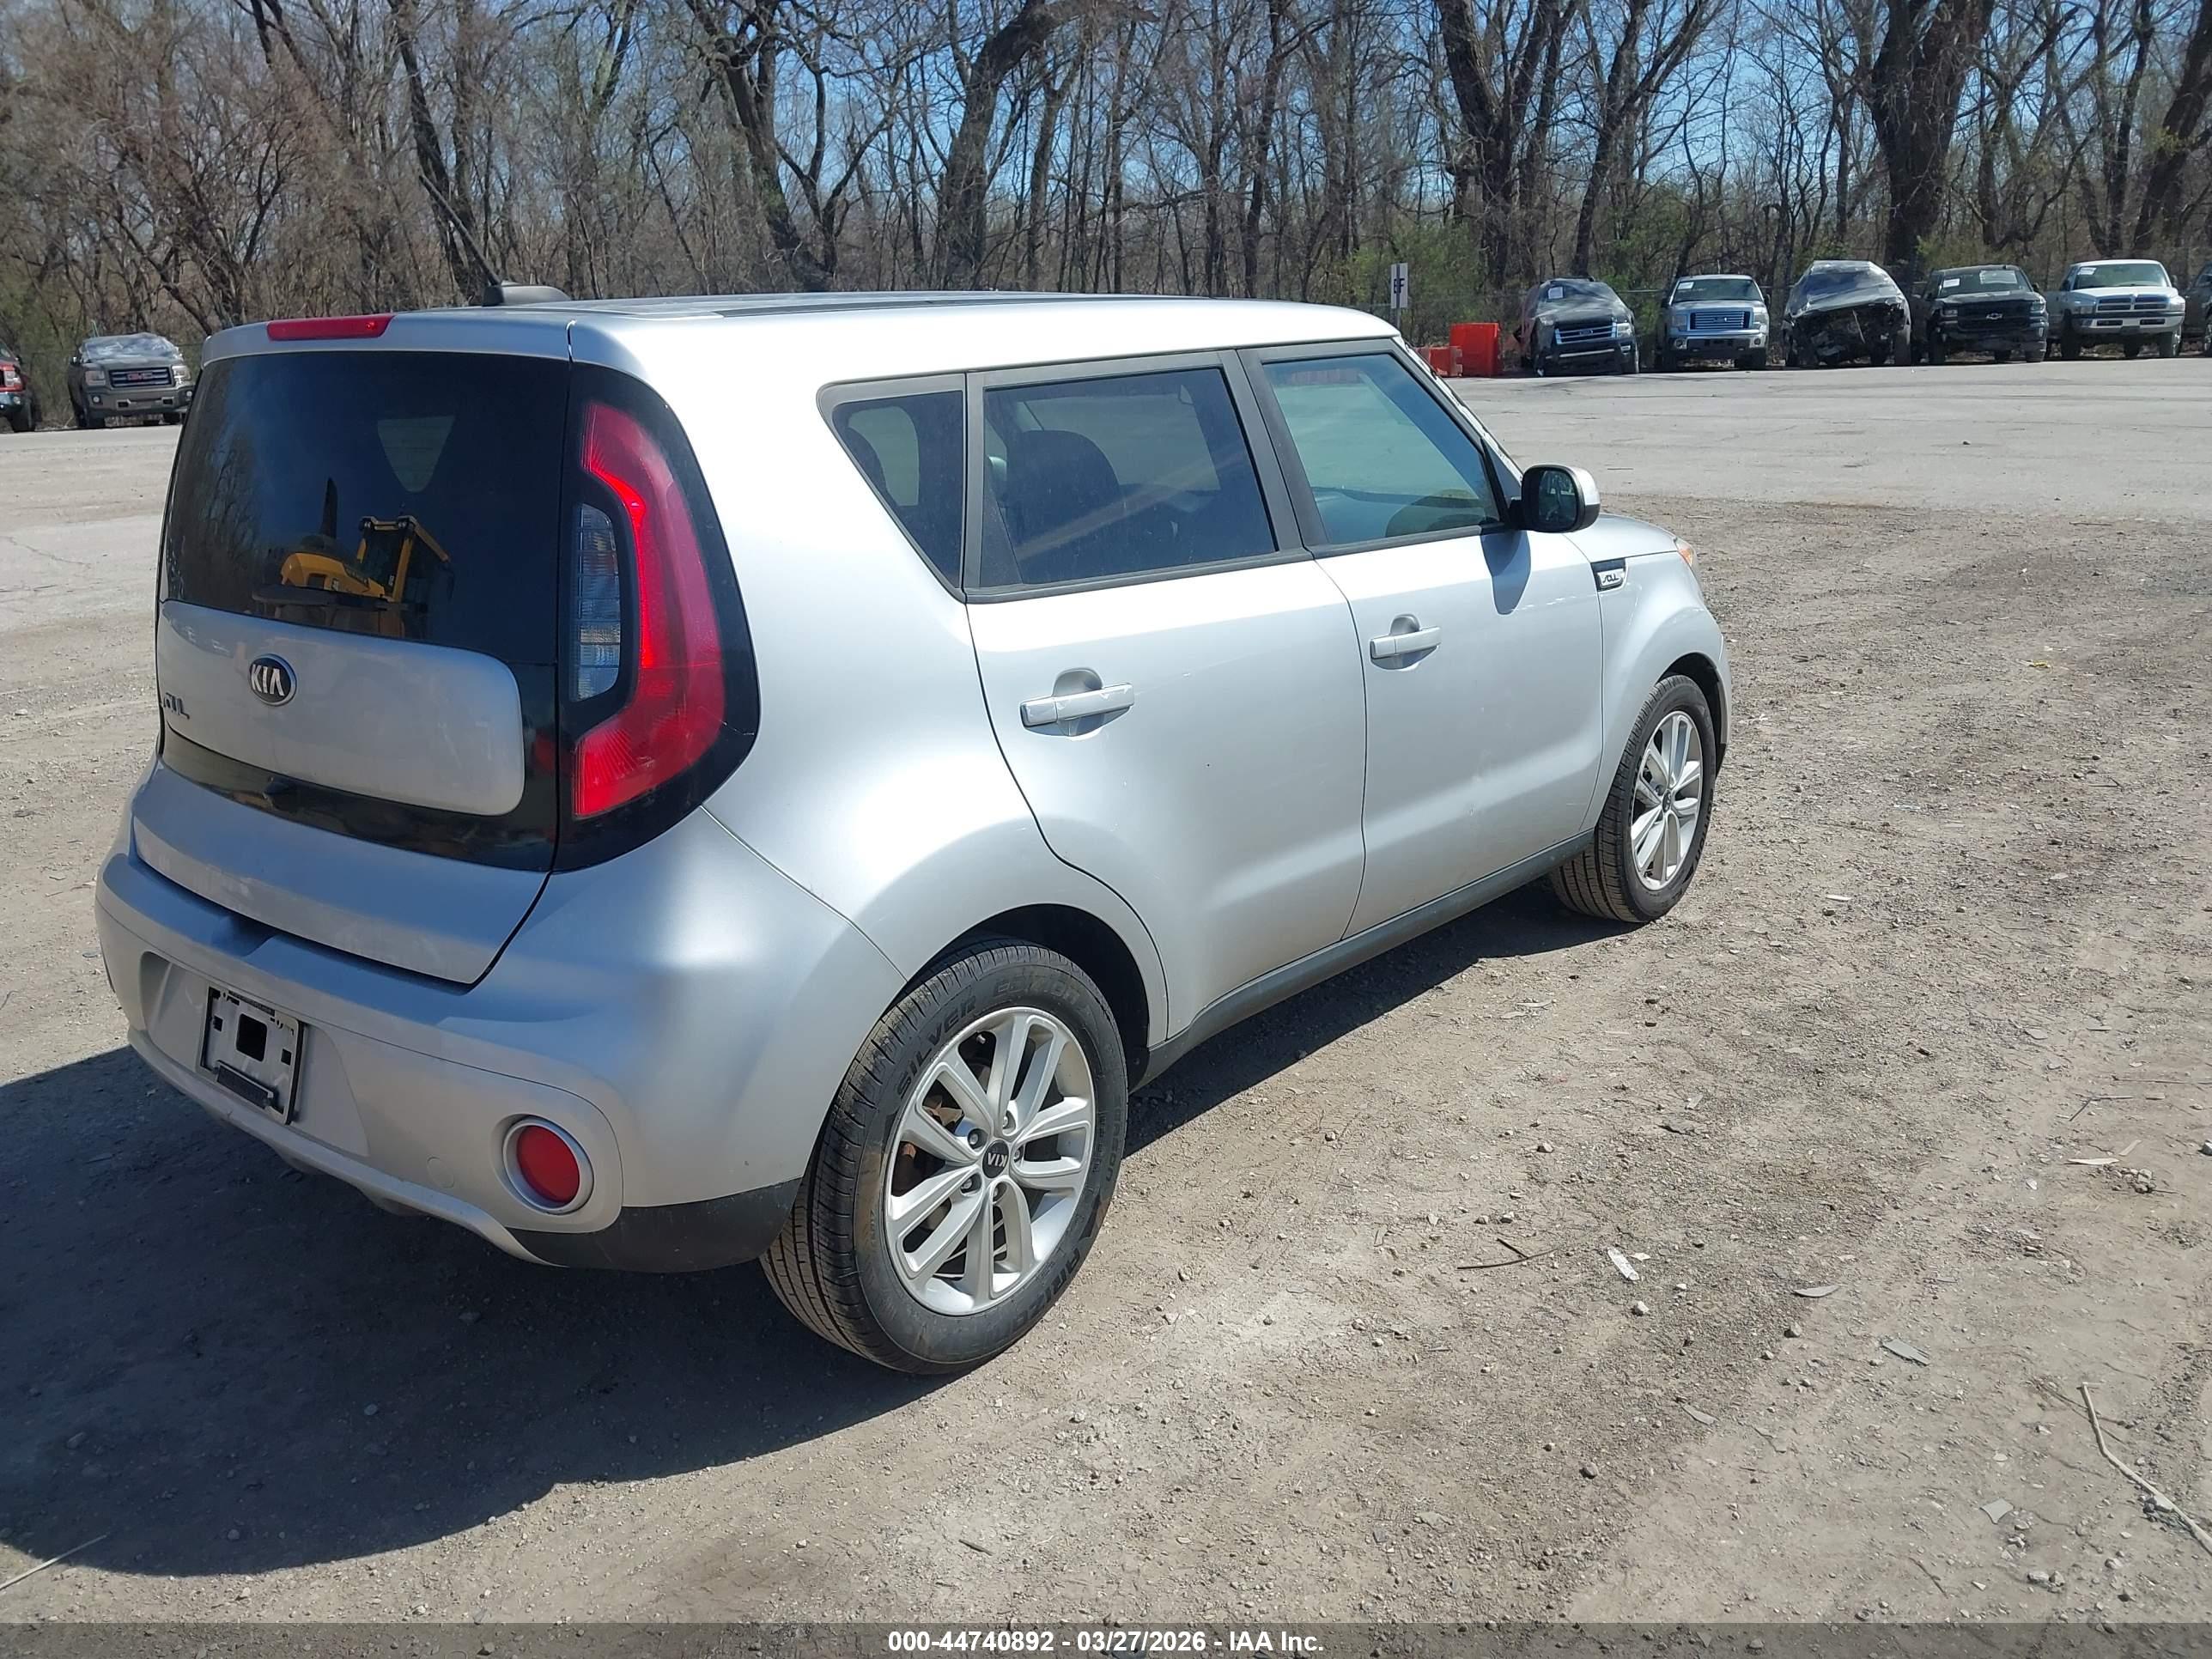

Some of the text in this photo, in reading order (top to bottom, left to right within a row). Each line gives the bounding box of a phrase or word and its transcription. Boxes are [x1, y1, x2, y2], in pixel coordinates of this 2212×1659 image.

[251, 663, 285, 696] KIA
[896, 994, 976, 1100] SILVER
[988, 1152, 1008, 1168] KIA
